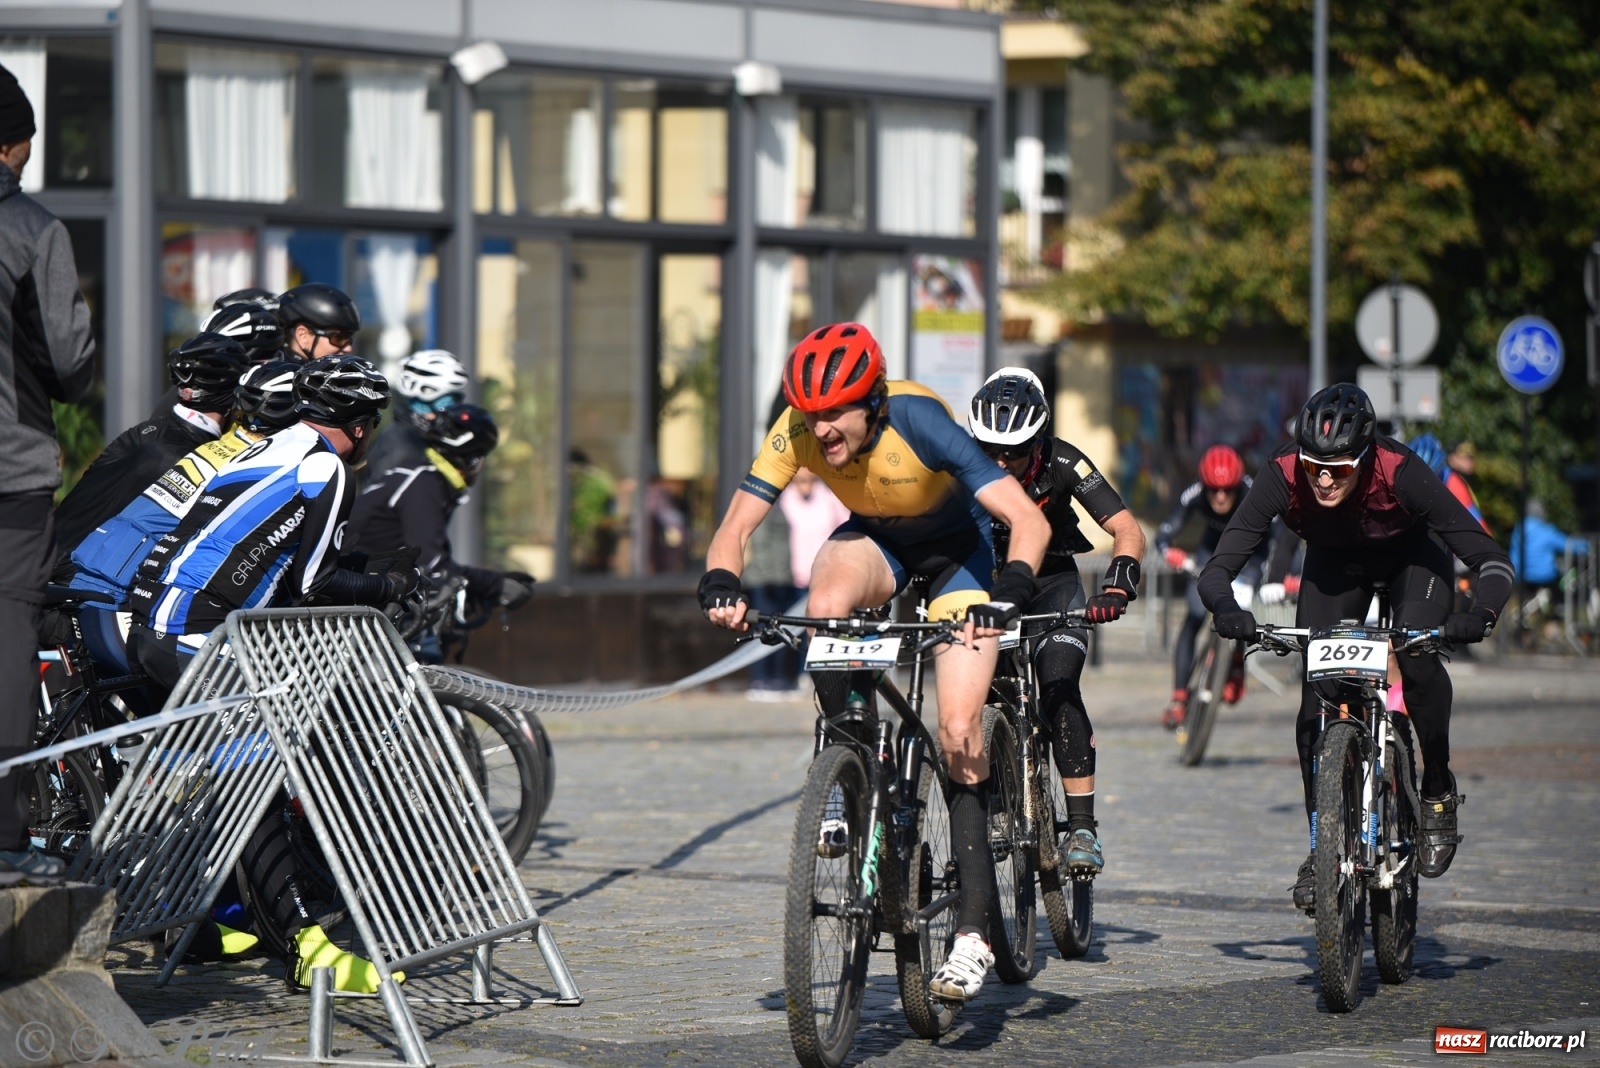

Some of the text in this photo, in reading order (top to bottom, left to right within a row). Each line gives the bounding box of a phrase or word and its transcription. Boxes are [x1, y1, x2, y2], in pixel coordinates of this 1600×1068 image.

[231, 542, 272, 586] GRUPA
[825, 643, 883, 654] 1119
[1319, 644, 1374, 662] 2697
